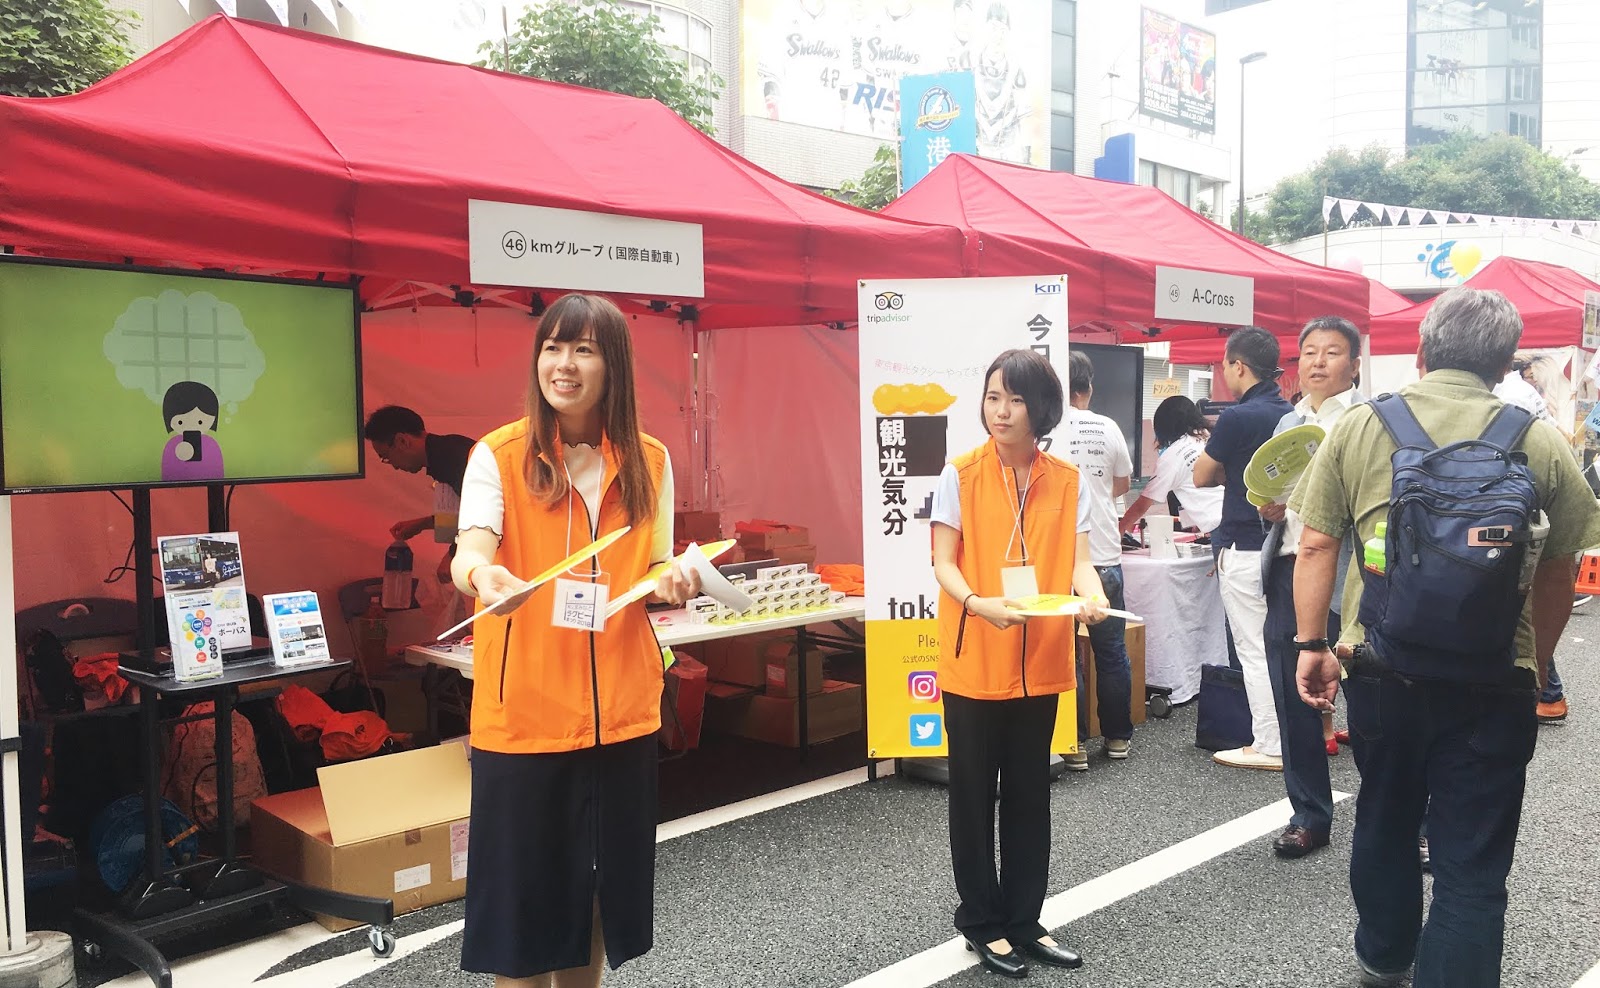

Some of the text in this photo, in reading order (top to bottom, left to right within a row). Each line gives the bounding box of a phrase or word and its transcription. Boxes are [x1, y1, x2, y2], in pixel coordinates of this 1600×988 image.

[786, 33, 840, 59] Swallows
[867, 36, 920, 64] Swallows
[820, 67, 840, 89] 42
[531, 239, 604, 257] kmグループ
[1035, 283, 1061, 293] km
[1192, 288, 1235, 307] A-Cross
[867, 314, 910, 324] tripadvisor
[880, 418, 907, 536] 観光気分
